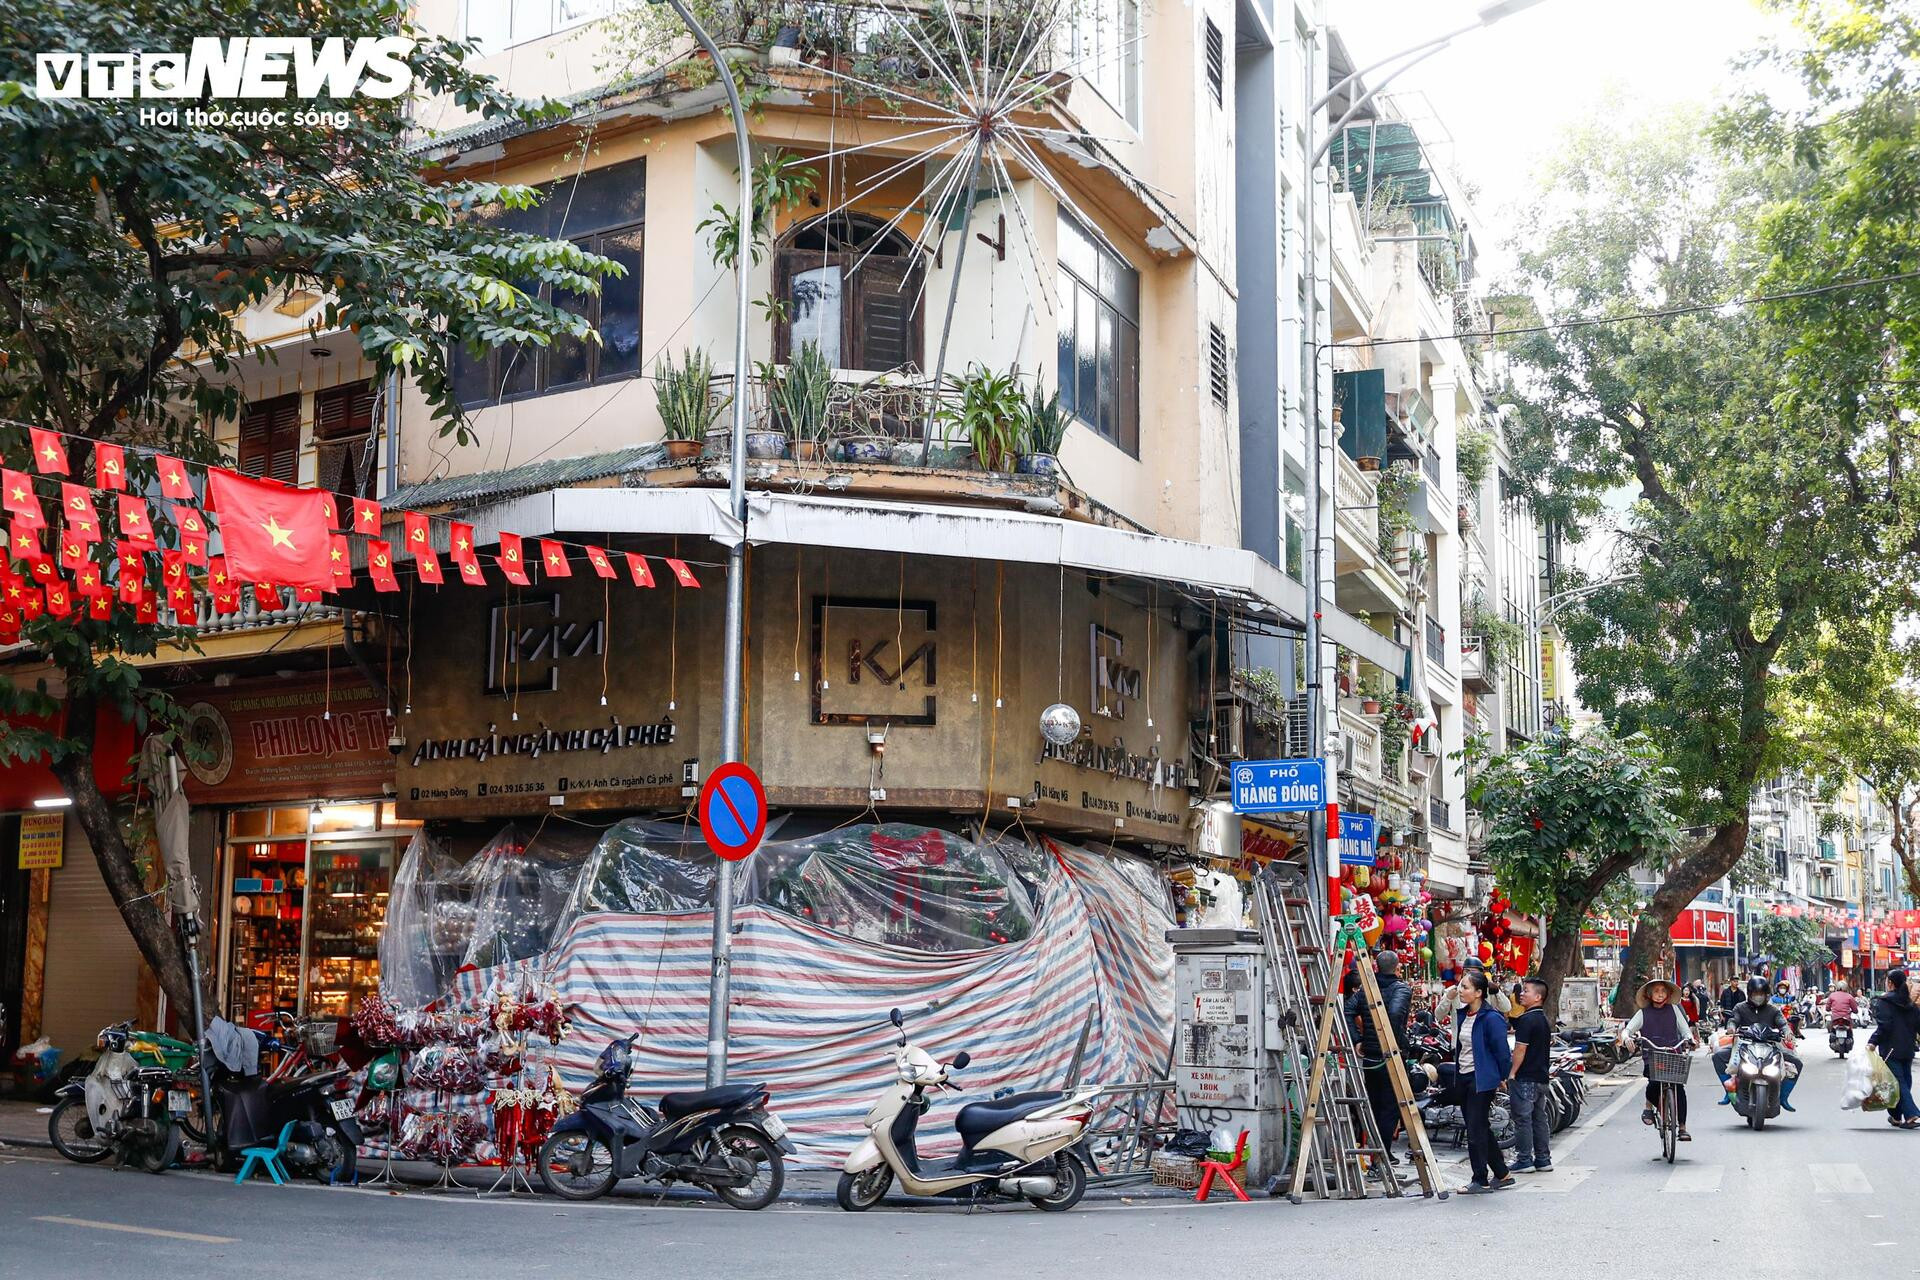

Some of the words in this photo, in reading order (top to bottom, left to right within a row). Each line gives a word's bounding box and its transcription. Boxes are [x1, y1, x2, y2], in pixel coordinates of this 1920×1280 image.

[1270, 765, 1299, 778] PHỐ
[421, 789, 430, 798] 02
[431, 788, 448, 799] Hàng
[450, 786, 468, 798] Đồng
[489, 785, 503, 794] 024
[535, 782, 545, 791] 36
[1240, 783, 1277, 804] HÀNG
[1281, 780, 1318, 803] ĐỒNG
[1351, 820, 1363, 831] PHỐ
[1339, 834, 1358, 856] HÀNG
[1361, 836, 1373, 857] MÃ
